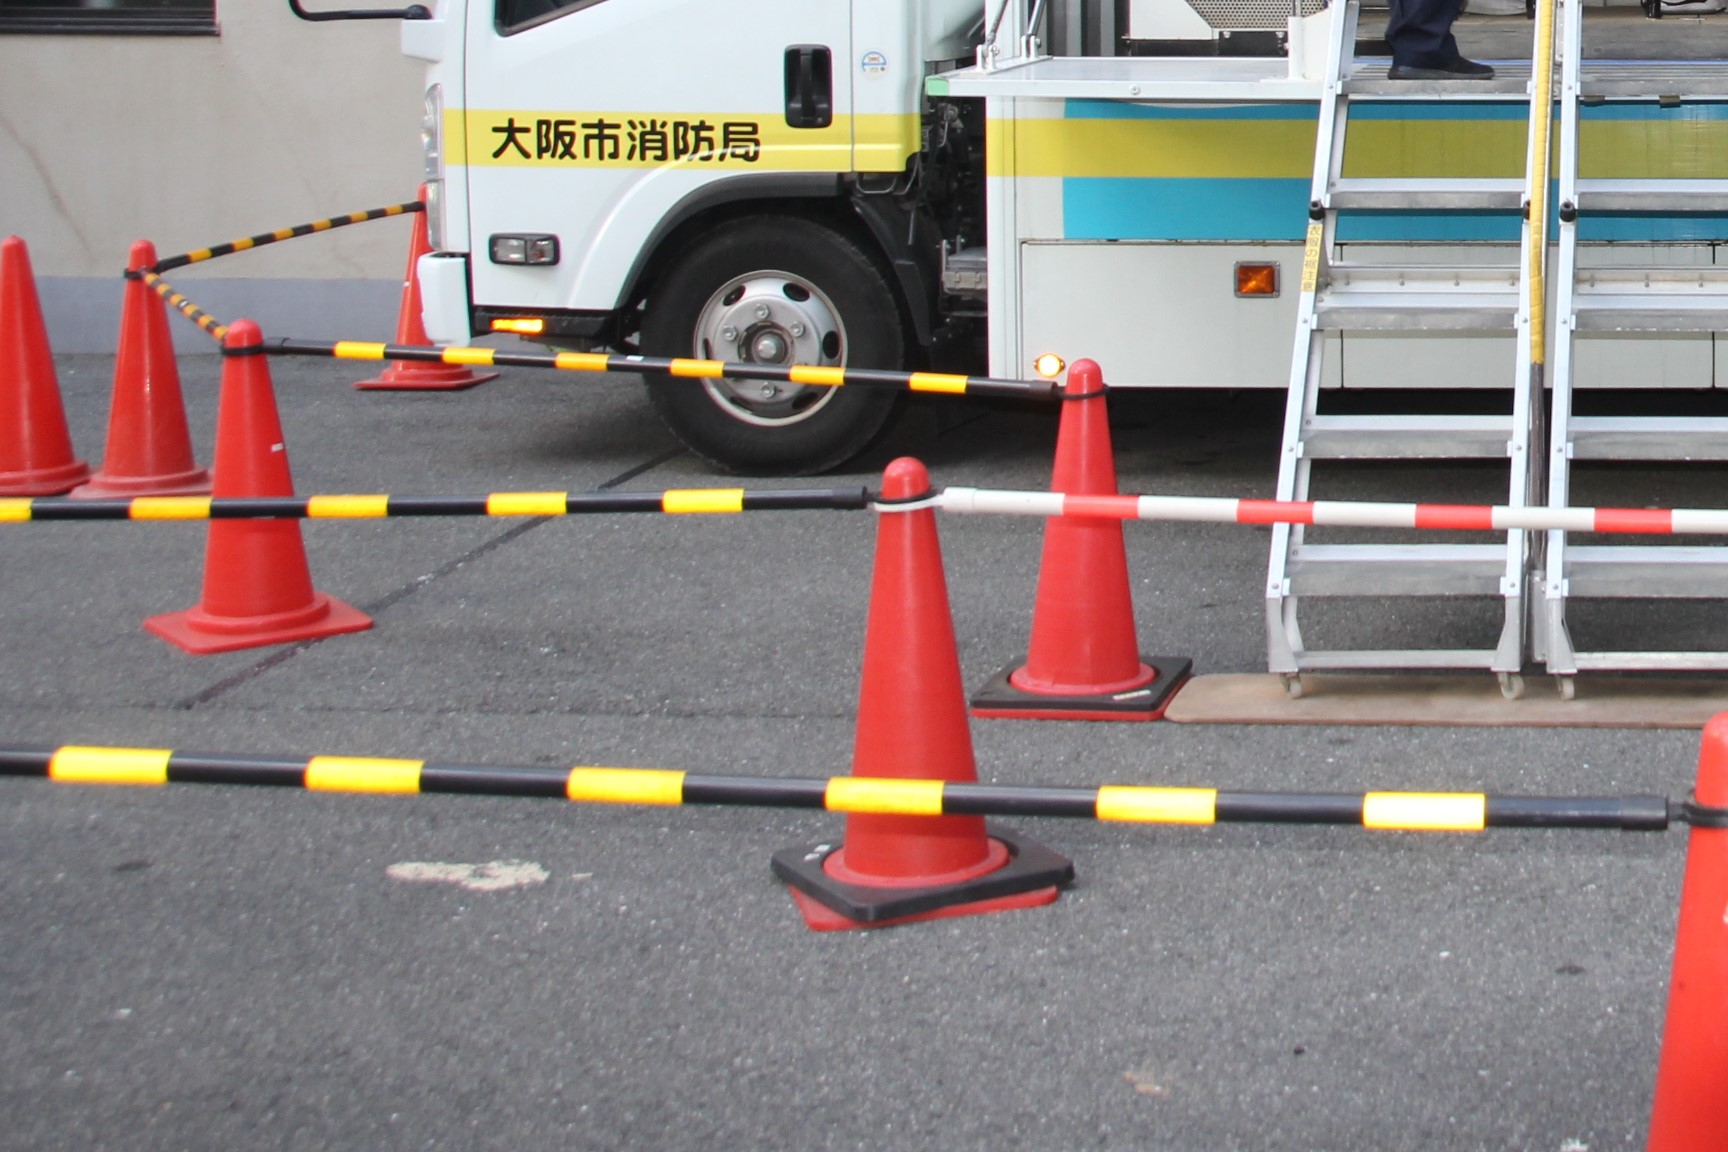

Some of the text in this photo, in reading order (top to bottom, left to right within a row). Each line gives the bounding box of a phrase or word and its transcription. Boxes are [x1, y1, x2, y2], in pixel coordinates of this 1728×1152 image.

[491, 118, 761, 163] 大阪市消防局
